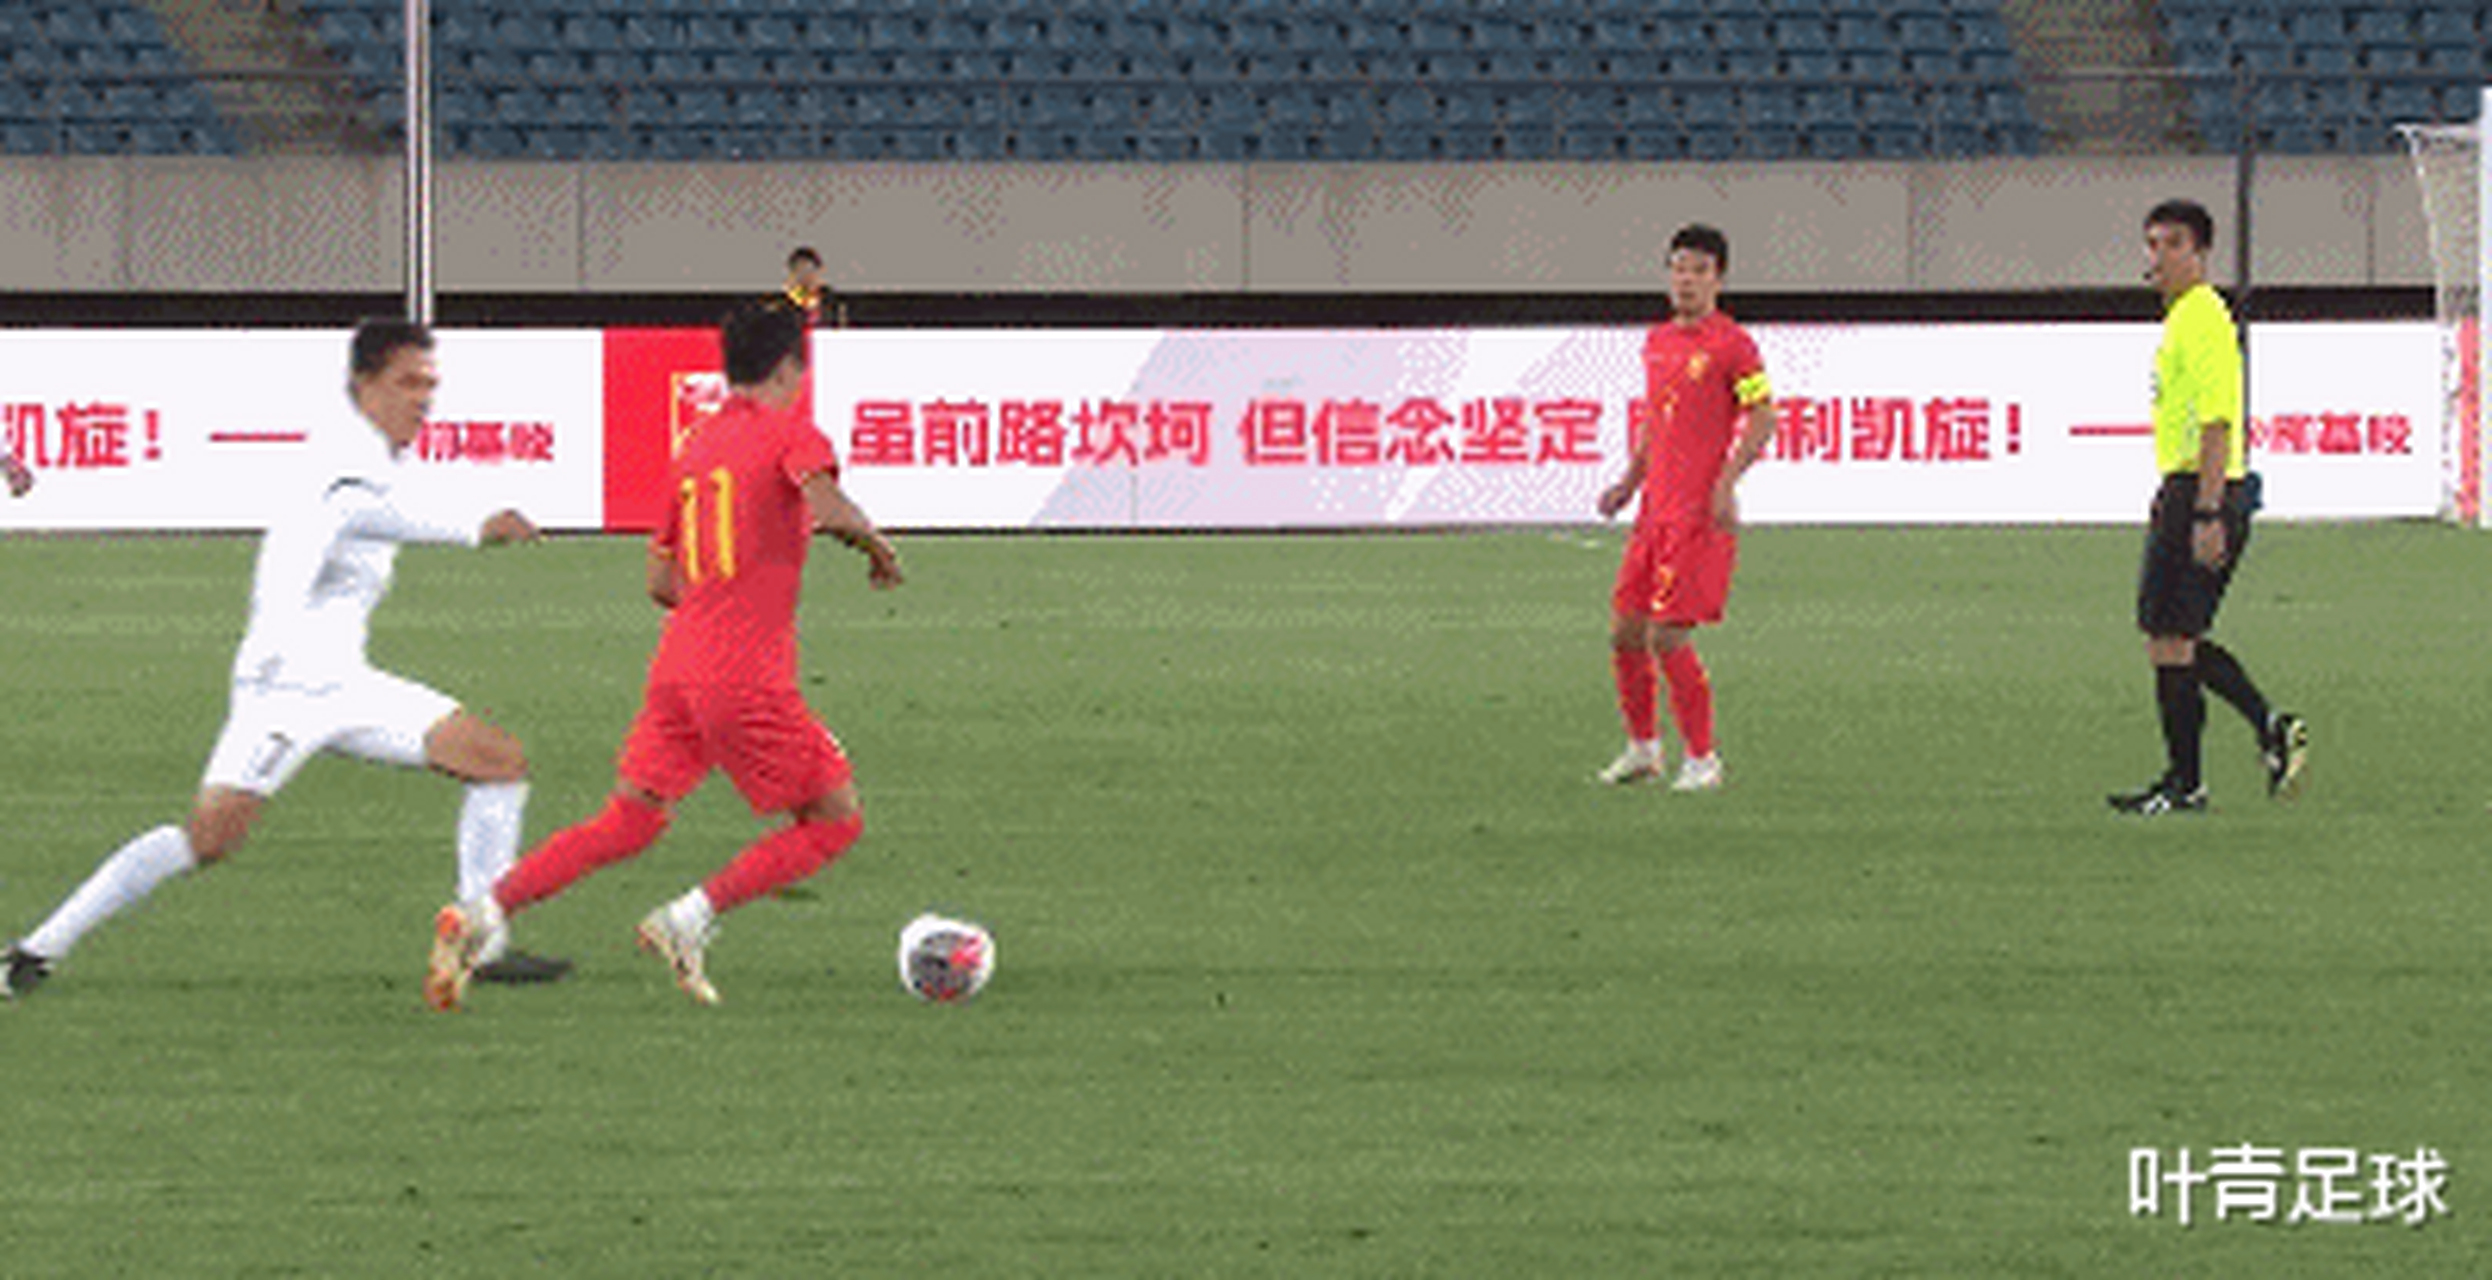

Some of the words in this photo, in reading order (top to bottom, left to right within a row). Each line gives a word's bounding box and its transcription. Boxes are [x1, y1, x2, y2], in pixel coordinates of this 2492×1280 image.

[1237, 395, 1603, 466] 但信念坚定
[679, 466, 735, 580] 11
